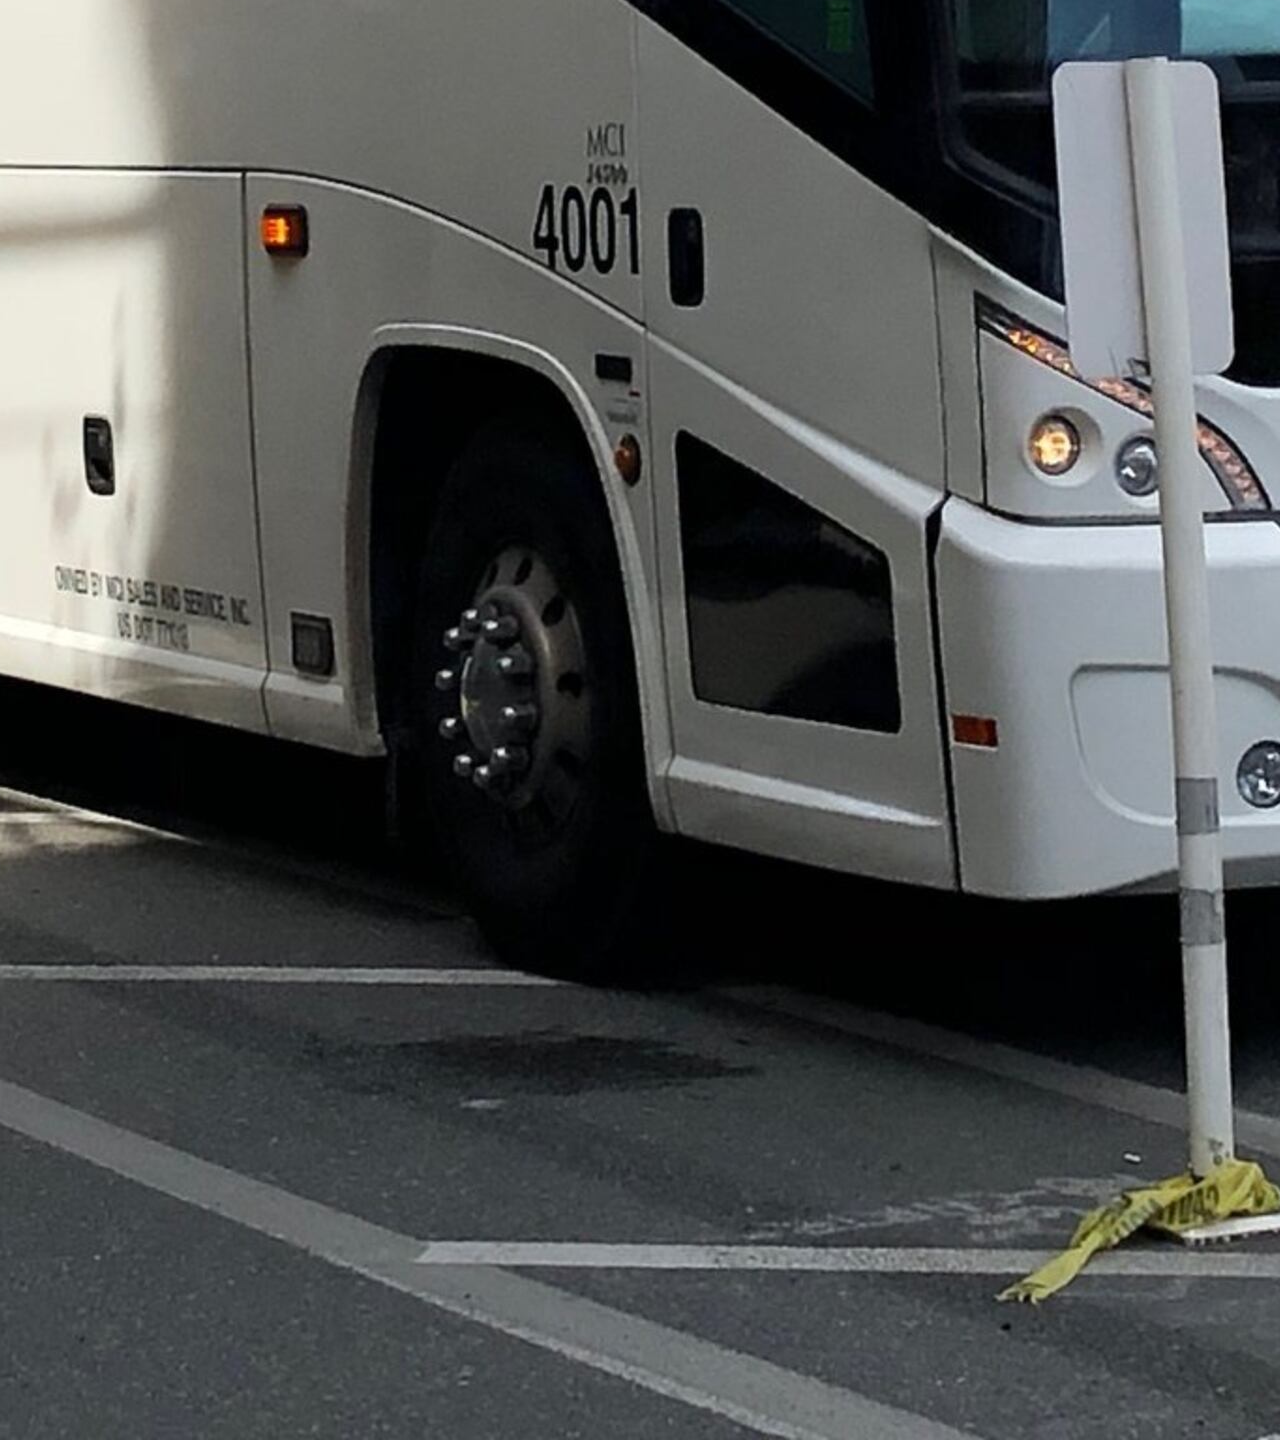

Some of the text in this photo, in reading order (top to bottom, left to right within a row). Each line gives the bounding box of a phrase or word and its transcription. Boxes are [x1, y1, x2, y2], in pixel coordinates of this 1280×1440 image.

[587, 122, 625, 158] MCI
[533, 183, 639, 275] 4001
[126, 577, 158, 609] SALES
[160, 583, 181, 613] AND
